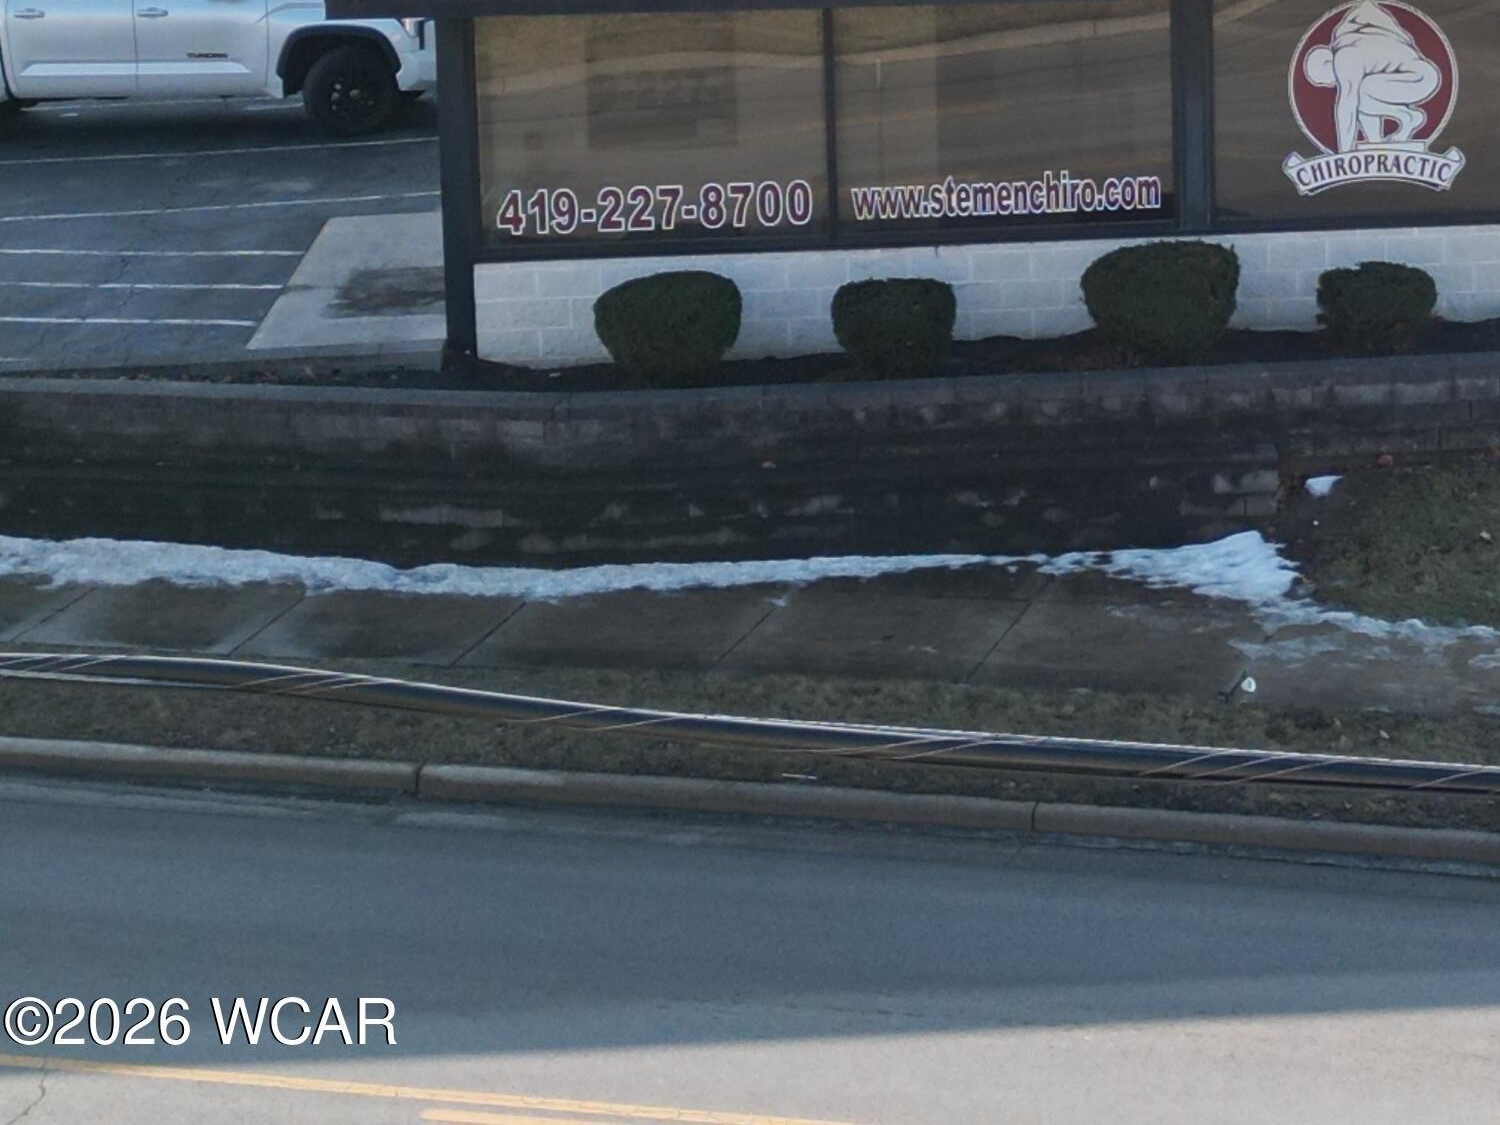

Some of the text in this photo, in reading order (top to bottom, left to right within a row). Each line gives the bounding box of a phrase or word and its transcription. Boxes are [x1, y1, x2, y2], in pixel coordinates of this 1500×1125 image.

[1297, 154, 1451, 187] CHIROPRACTIC
[497, 180, 812, 235] 419-227-8700
[851, 171, 1161, 220] www.stemenchiro.com
